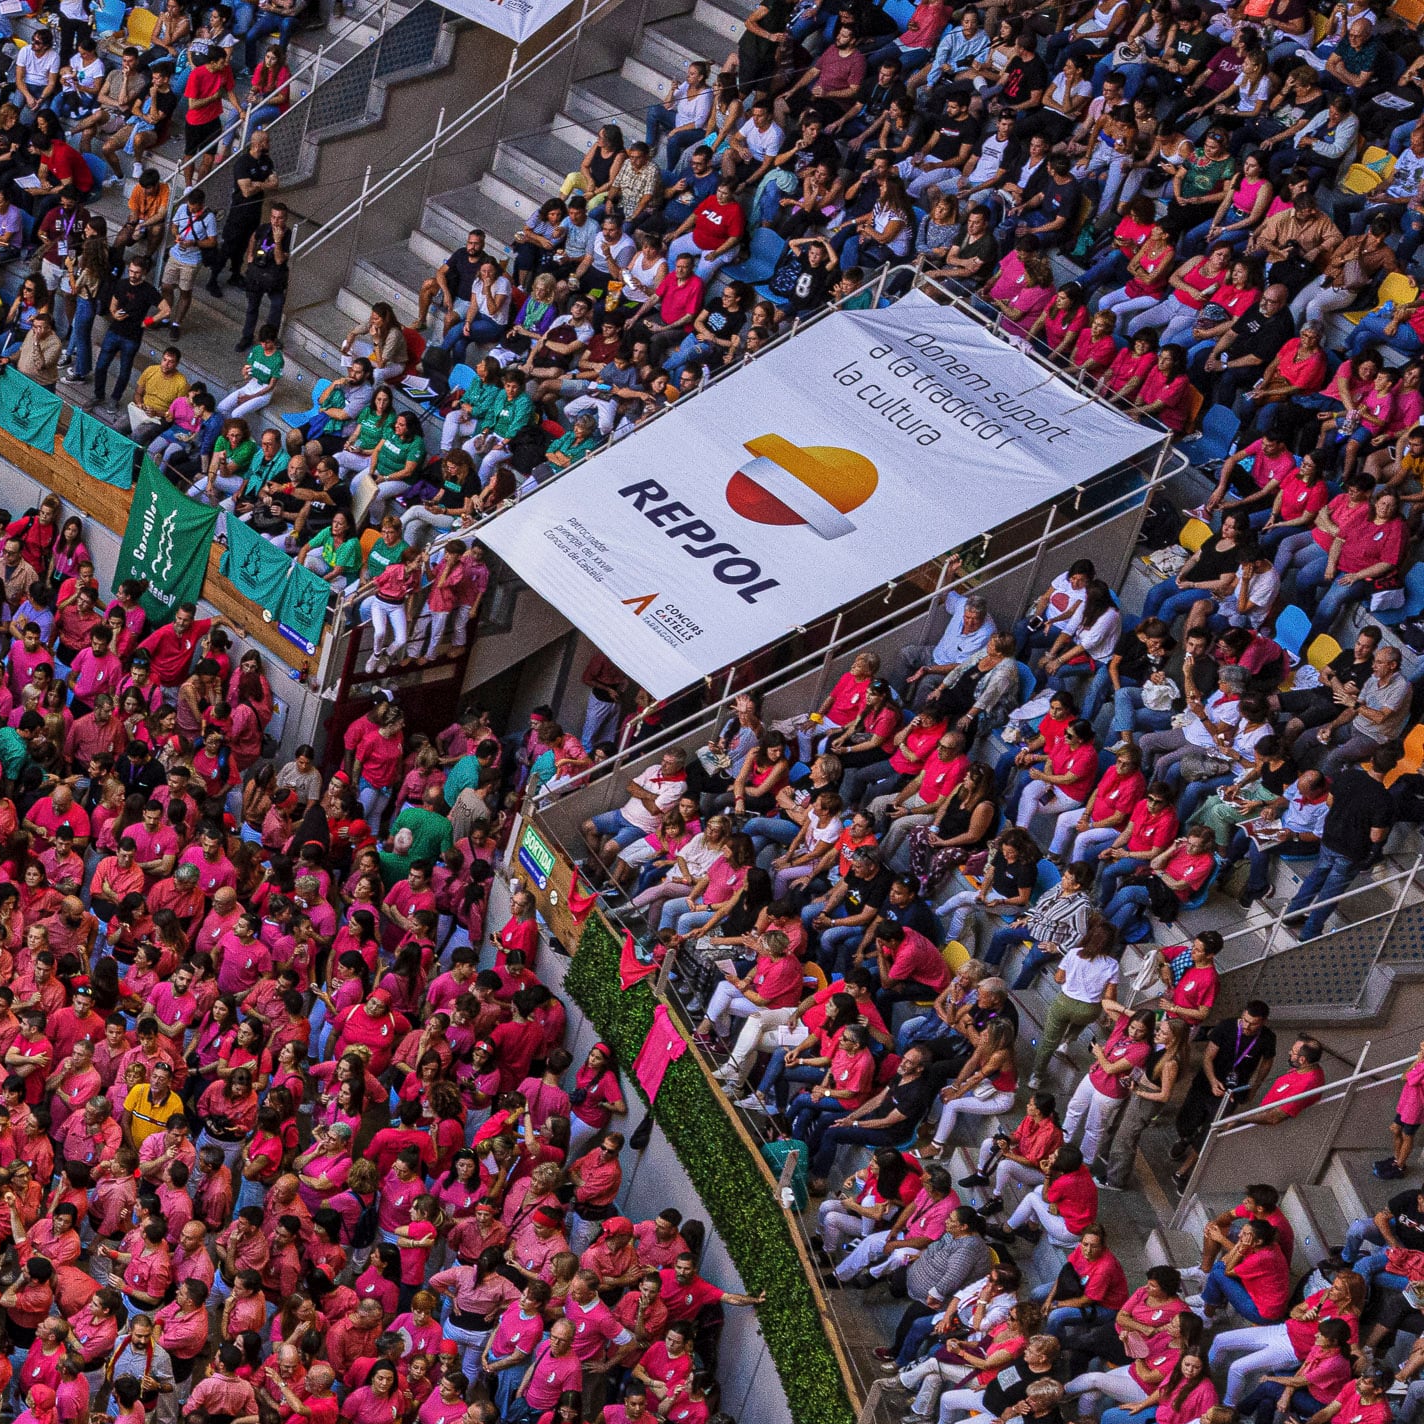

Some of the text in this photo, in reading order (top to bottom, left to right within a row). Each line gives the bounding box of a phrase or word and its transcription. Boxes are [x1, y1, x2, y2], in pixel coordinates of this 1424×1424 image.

[701, 209, 722, 225] FILA
[796, 273, 812, 297] 8
[833, 361, 943, 446] la cultura
[869, 344, 894, 359] a
[918, 370, 1005, 440] tradició
[904, 332, 1072, 446] Donem suport
[543, 528, 568, 554] Concurs
[576, 556, 604, 584] Castells
[618, 479, 780, 605] REPSOL
[655, 609, 694, 642] CASTELLS
[665, 603, 704, 637] CONCURS
[522, 829, 553, 874] SORTIDA
